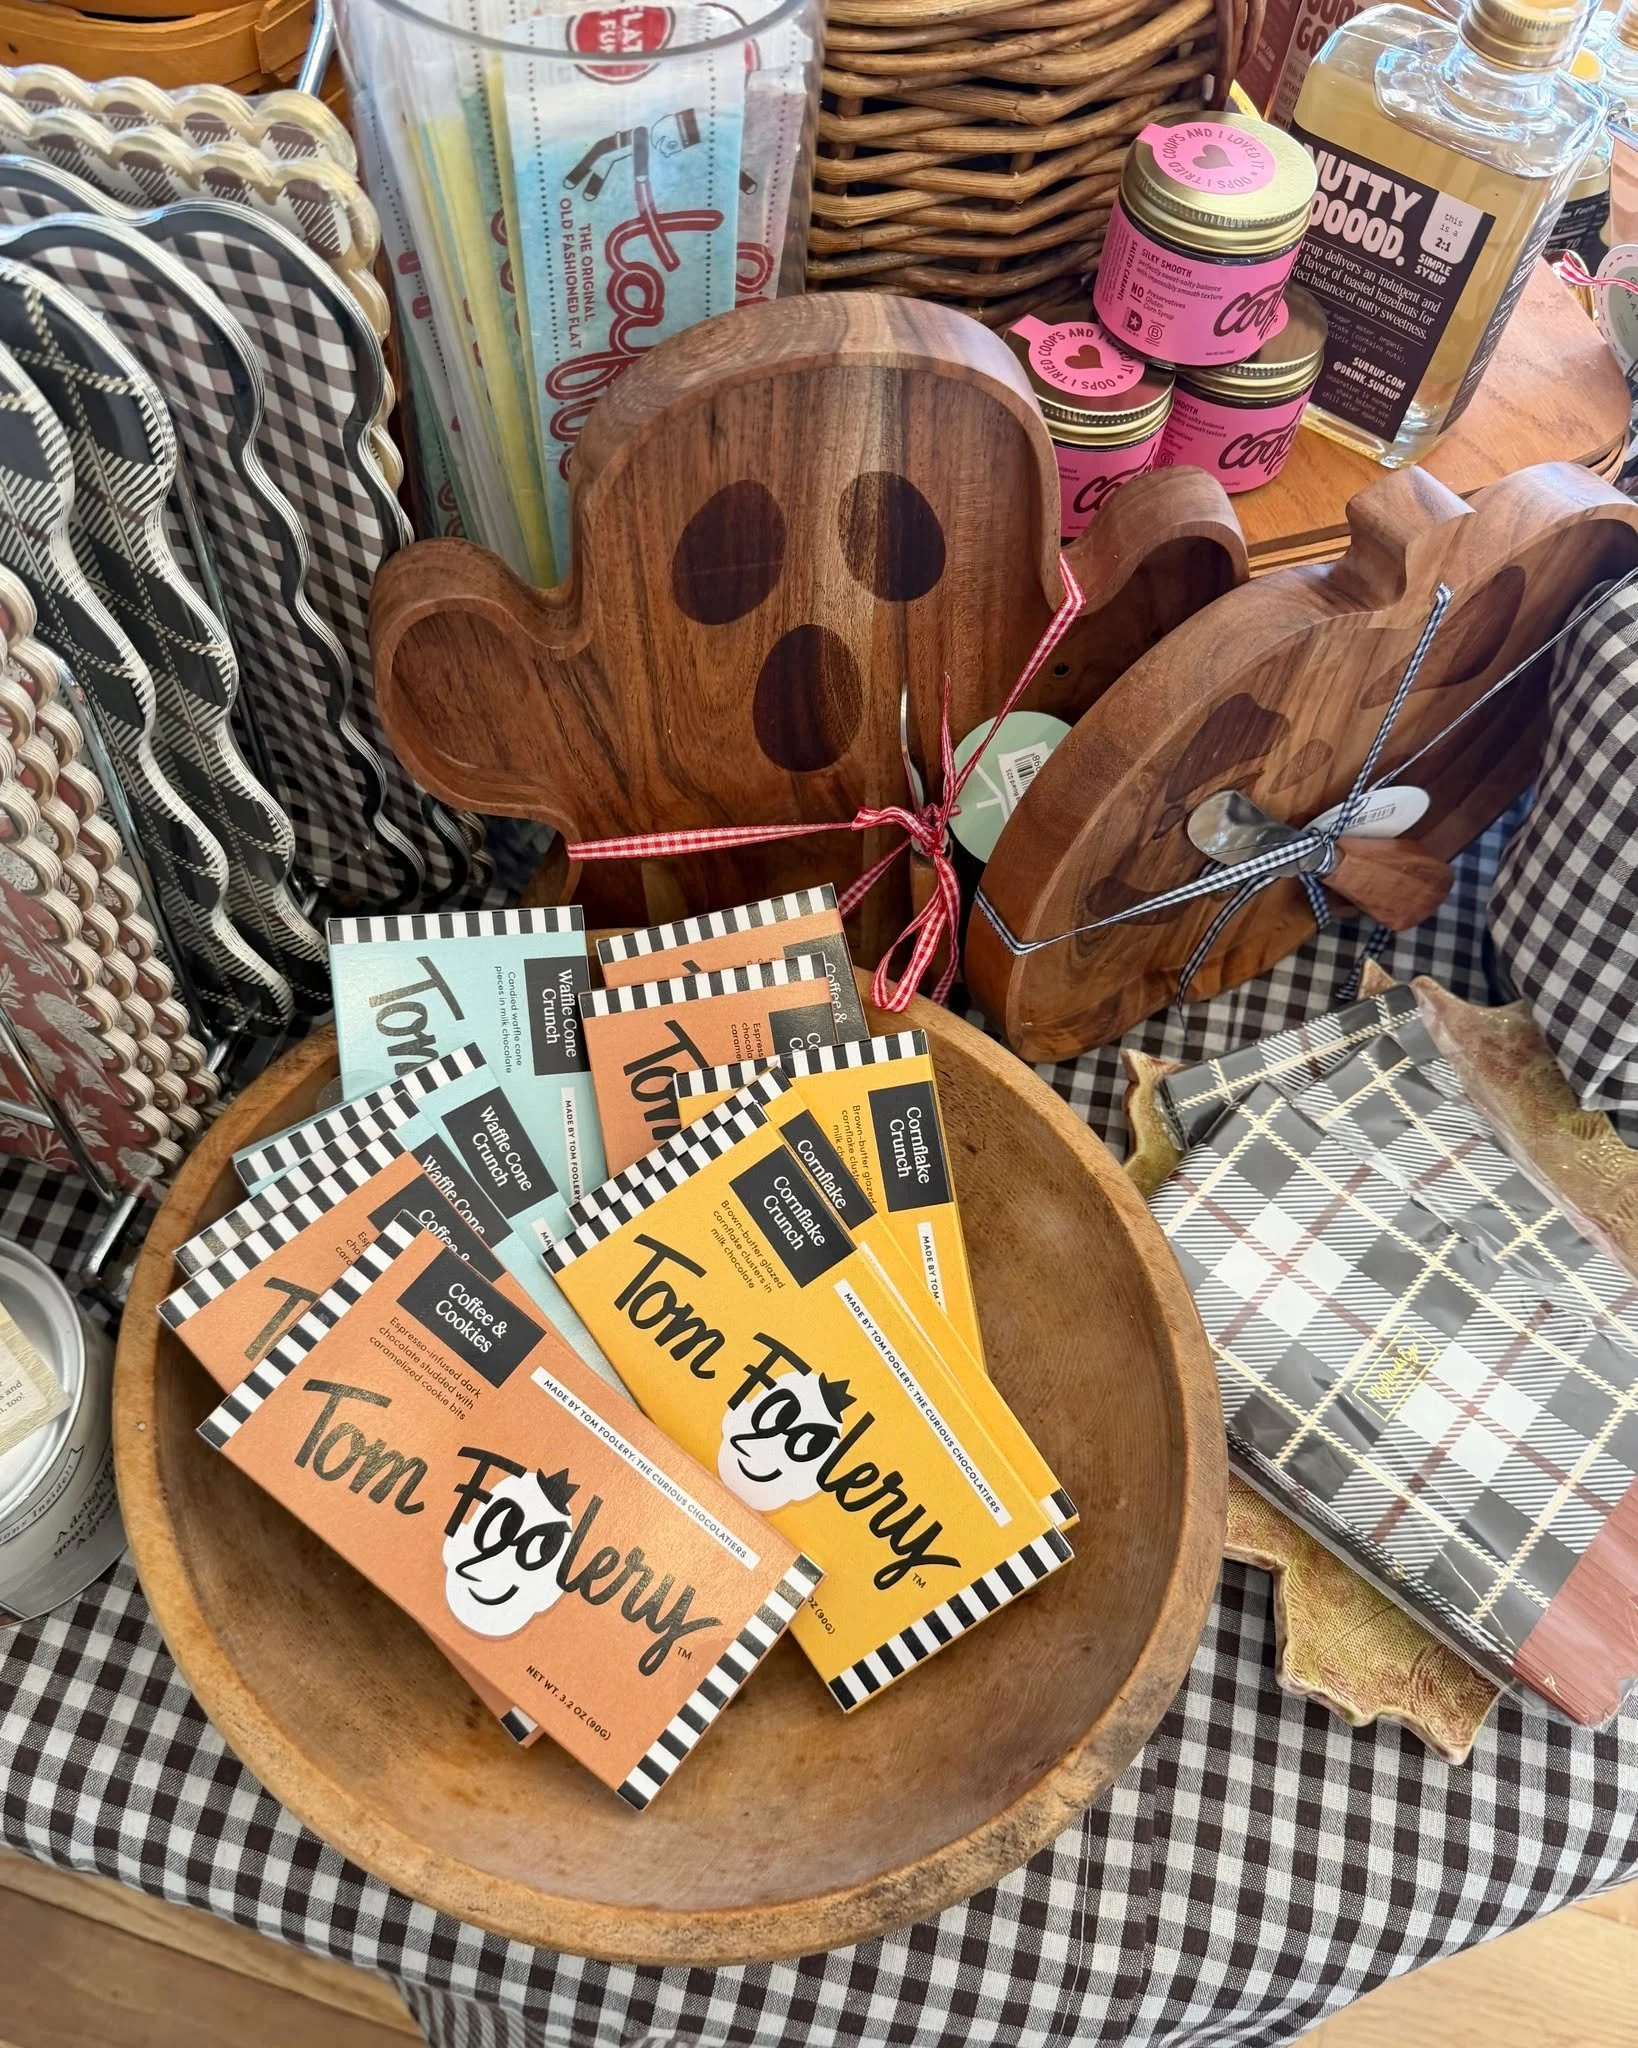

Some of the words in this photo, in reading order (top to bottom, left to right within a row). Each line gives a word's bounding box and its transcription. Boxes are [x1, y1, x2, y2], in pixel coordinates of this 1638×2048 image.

[1186, 127, 1213, 139] AND
[1227, 133, 1260, 160] LOVED
[1172, 160, 1202, 185] TRIED
[1216, 175, 1253, 190] OOPS
[1251, 160, 1265, 171] IT
[559, 198, 573, 230] OLD
[1309, 190, 1405, 267] OOOOD.
[1439, 224, 1450, 233] is
[1444, 213, 1464, 227] this
[578, 223, 592, 252] THE
[1434, 237, 1451, 253] 2:1
[563, 232, 580, 314] FASHIONED
[1142, 249, 1160, 264] SILKY
[1161, 260, 1193, 278] SMOOTH
[1301, 241, 1323, 258] rrup
[1325, 250, 1363, 275] delivers
[1363, 267, 1377, 282] an
[1378, 274, 1421, 303] indulgent
[1421, 296, 1442, 314] and
[1414, 265, 1447, 286] SYRUP
[1417, 254, 1453, 276] SIMPLE
[580, 253, 597, 322] ORIGINAL
[1131, 282, 1144, 298] NO
[1292, 266, 1310, 283] fect
[1310, 273, 1346, 299] balance
[1345, 289, 1357, 303] of
[1356, 294, 1381, 318] nutty
[1380, 308, 1427, 340] sweetness.
[1302, 253, 1331, 275] flavor
[1331, 267, 1343, 281] of
[1343, 273, 1376, 298] toasted
[1377, 288, 1419, 319] hazelnuts
[1418, 308, 1436, 326] for
[567, 315, 583, 350] FLAT
[1069, 327, 1094, 339] AND
[1040, 360, 1068, 384] TRIED
[1081, 378, 1116, 390] OOPS
[1120, 364, 1134, 375] IT
[1333, 361, 1401, 401] @DRINK.SURRUP
[1352, 357, 1406, 391] SURRUP.COM
[494, 965, 505, 996] pieces
[508, 971, 519, 1012] Candied
[558, 968, 577, 1016] Waffle
[825, 962, 842, 1010] Coffee
[834, 1012, 848, 1024] &
[369, 956, 465, 1079] Tom
[500, 1007, 508, 1026] milk
[512, 1013, 522, 1042] waffle
[542, 988, 561, 1045] Crunch
[502, 1028, 512, 1074] chocolate
[562, 1019, 578, 1058] Cone
[730, 1024, 744, 1062] caramel
[741, 1022, 754, 1059] chocola
[752, 1022, 765, 1058] Espress
[565, 1100, 574, 1125] MADE
[480, 1105, 511, 1153] Waffle
[505, 1152, 533, 1192] Cone
[567, 1127, 576, 1139] BY
[569, 1140, 577, 1160] TOM
[832, 1124, 842, 1144] milk
[841, 1109, 856, 1154] cornflake
[849, 1155, 860, 1183] clust
[852, 1104, 869, 1169] Brown-butter
[889, 1118, 913, 1179] Crunch
[906, 1106, 932, 1185] Cornflake
[472, 1131, 509, 1188] Crunch
[796, 1139, 847, 1209] Cornflake
[422, 1154, 458, 1201] Waffle
[454, 1198, 486, 1236] Cone
[773, 1176, 826, 1247] Cornflake
[418, 1208, 459, 1253] Coffee
[763, 1195, 805, 1251] Crunch
[710, 1227, 727, 1248] milk
[723, 1246, 755, 1290] chocolate
[713, 1210, 743, 1251] cornflake
[741, 1249, 766, 1285] clusters
[763, 1282, 773, 1294] in
[720, 1199, 764, 1259] Brown-butter
[759, 1258, 786, 1290] glazed
[922, 1235, 933, 1263] MADE
[927, 1264, 937, 1280] BY
[930, 1280, 941, 1301] TOM
[435, 1299, 493, 1354] Cookies
[448, 1282, 494, 1327] Coffee
[491, 1320, 508, 1339] &
[379, 1326, 421, 1364] chocolate
[420, 1361, 457, 1394] studded
[455, 1391, 475, 1411] with
[389, 1316, 463, 1381] Espresso-infused
[460, 1378, 482, 1400] dark
[5, 1379, 24, 1396] and
[369, 1336, 423, 1383] caramelized
[421, 1381, 450, 1406] cookie
[448, 1402, 466, 1421] bits
[614, 1233, 726, 1380] Tom
[727, 1331, 962, 1591] Foolery
[844, 1292, 865, 1319] MADE
[862, 1316, 874, 1331] BY
[870, 1329, 887, 1352] TOM
[884, 1350, 916, 1393] FOOLERY:
[912, 1390, 927, 1410] THE
[924, 1408, 955, 1449] CURIOUS
[951, 1446, 1001, 1515] CHOCOLATIERS
[544, 1379, 569, 1403] MADE
[567, 1399, 582, 1413] BY
[580, 1410, 599, 1430] TOM
[597, 1425, 637, 1463] FOOLERY:
[635, 1458, 652, 1477] THE
[651, 1472, 688, 1508] CURIOUS
[687, 1503, 748, 1560] CHOCOLATIERS
[294, 1378, 429, 1515] Tom
[443, 1445, 723, 1677] Foolery
[911, 1572, 928, 1589] TM
[814, 1608, 836, 1635] (90G)
[677, 1646, 693, 1661] TM
[526, 1664, 546, 1683] NET
[543, 1679, 560, 1698] WT.
[559, 1693, 575, 1710] 3.2
[573, 1706, 589, 1721] OZ
[585, 1716, 612, 1741] (90G)
